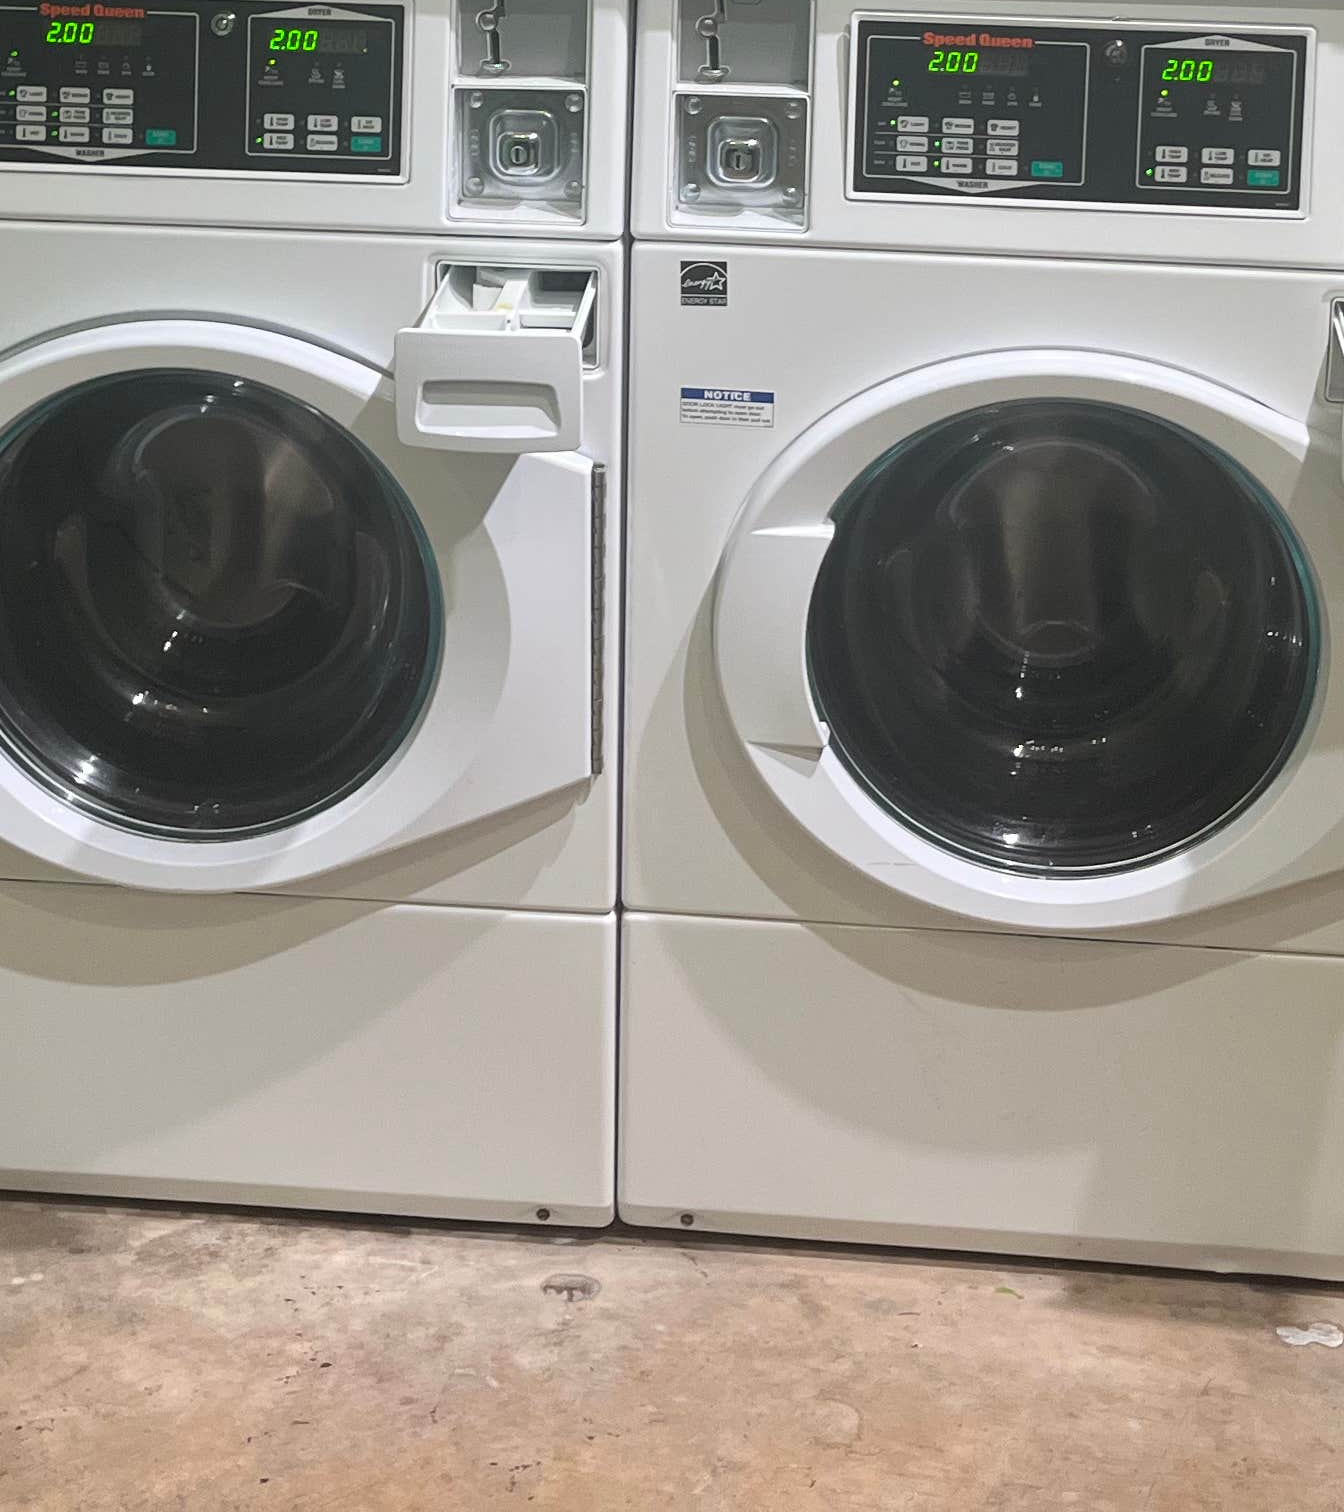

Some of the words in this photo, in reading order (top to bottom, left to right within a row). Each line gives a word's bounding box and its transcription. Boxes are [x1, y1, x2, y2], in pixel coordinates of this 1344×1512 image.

[39, 3, 92, 18] Speed
[94, 5, 145, 18] Queen
[47, 22, 94, 44] 2.00
[269, 29, 318, 52] 2.00
[922, 32, 976, 48] Speed
[979, 34, 1033, 49] Queen
[1204, 38, 1230, 46] DRYER
[928, 51, 978, 74] 2.00
[1162, 60, 1213, 83] 2.00
[957, 180, 988, 189] WASHER
[704, 390, 751, 401] NOTICE
